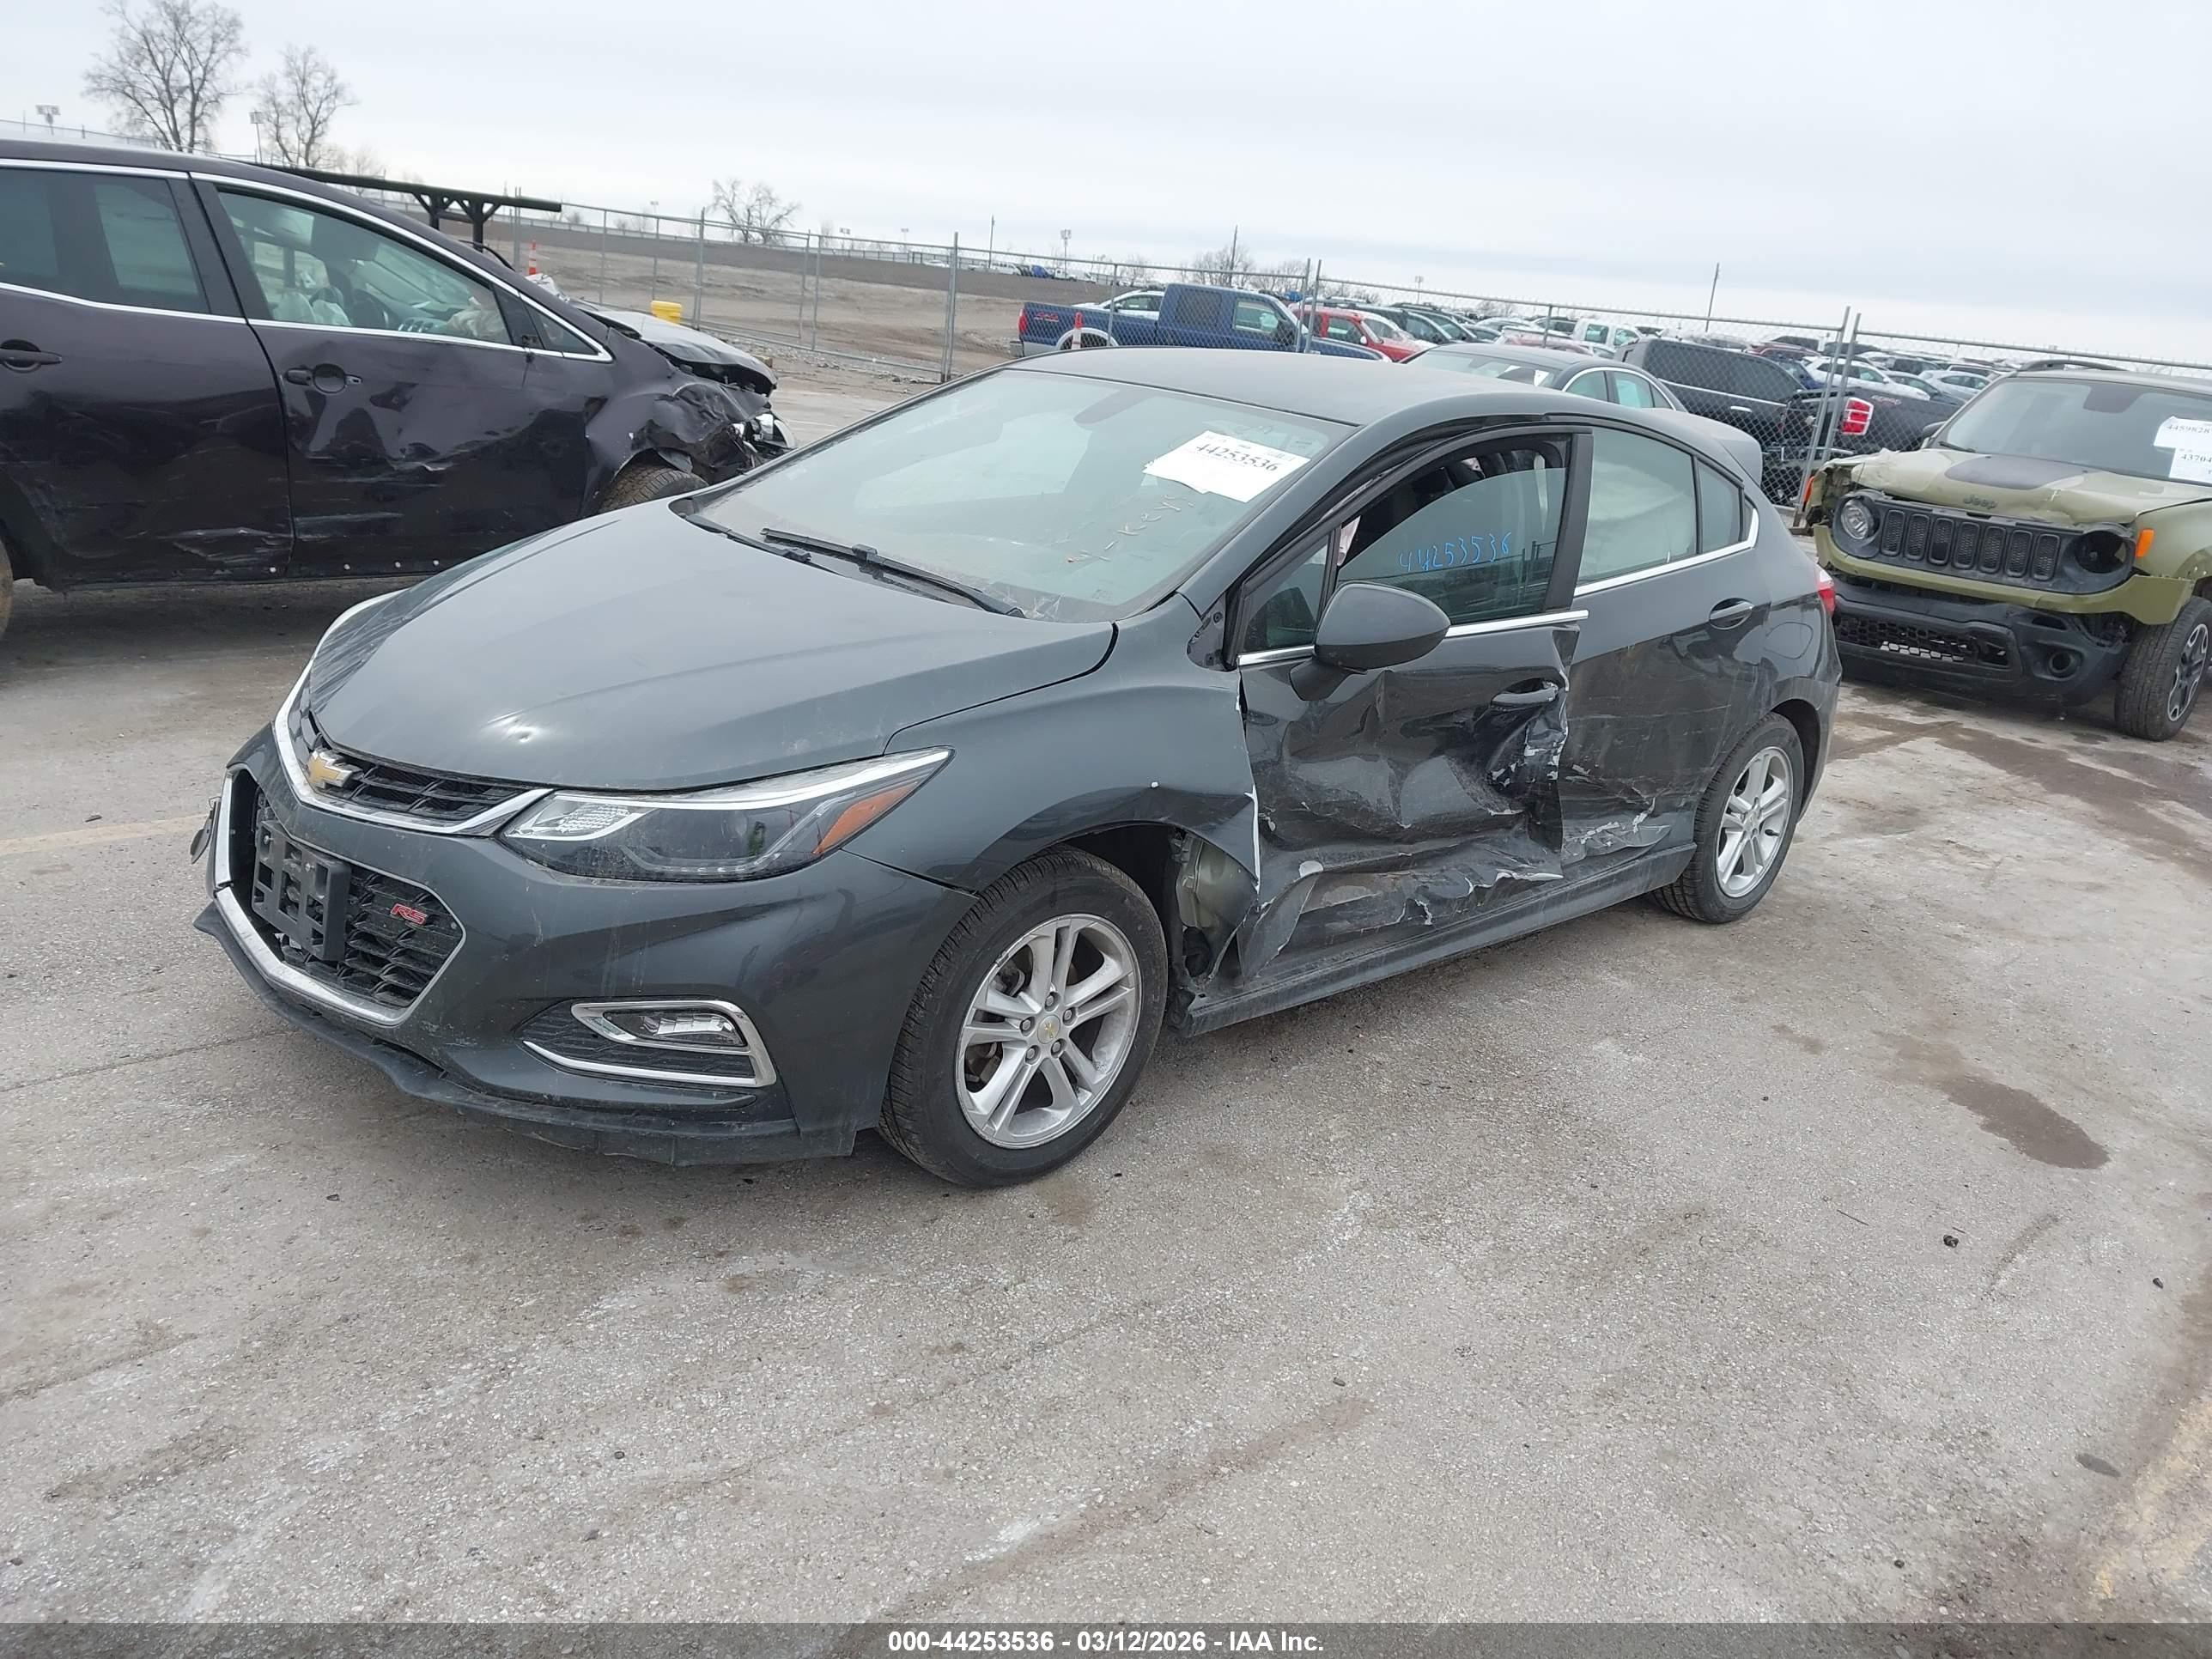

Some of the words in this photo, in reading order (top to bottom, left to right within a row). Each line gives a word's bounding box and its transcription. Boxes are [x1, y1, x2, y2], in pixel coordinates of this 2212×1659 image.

[1195, 443, 1279, 472] 44253536
[1964, 495, 1999, 510] Jeep
[1398, 531, 1513, 573] 44253536
[390, 902, 428, 926] RS
